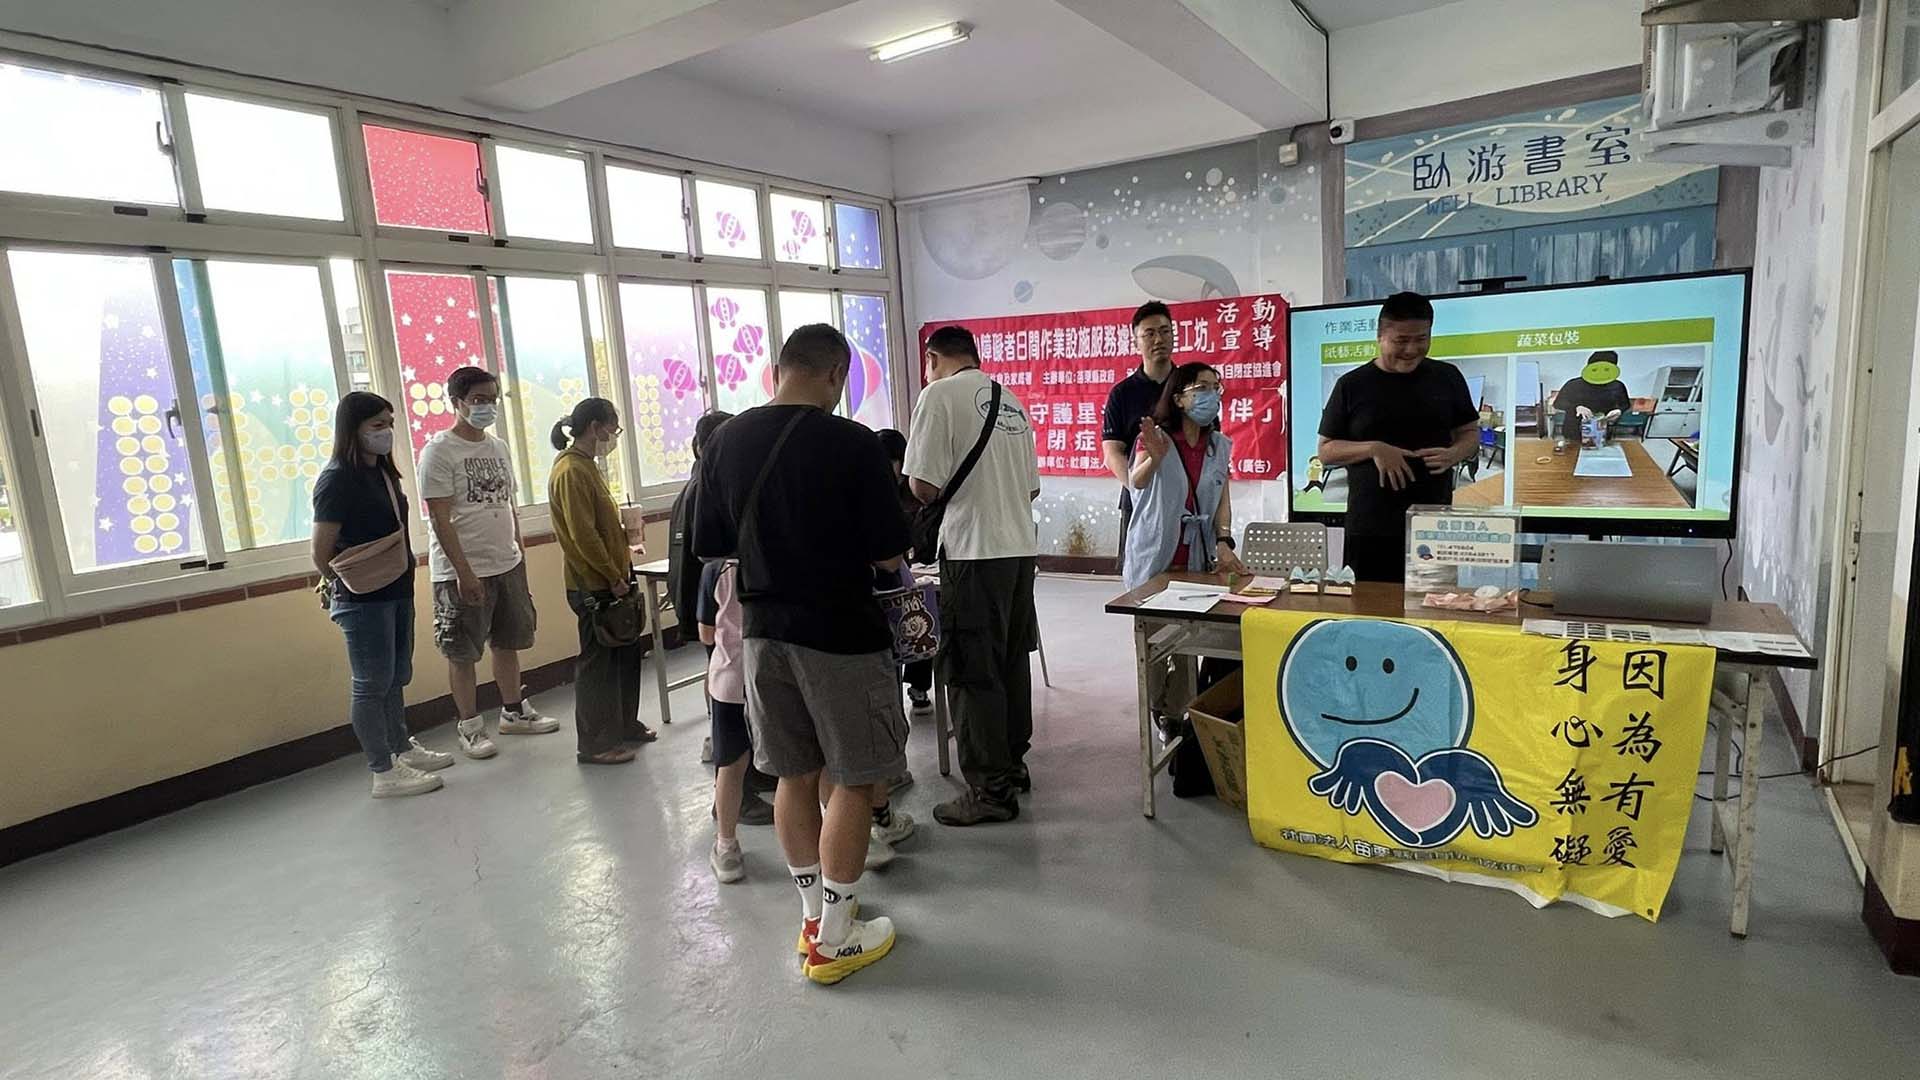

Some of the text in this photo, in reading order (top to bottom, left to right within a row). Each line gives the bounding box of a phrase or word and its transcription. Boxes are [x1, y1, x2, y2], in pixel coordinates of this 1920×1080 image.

[1413, 126, 1631, 191] 臥游書室
[1427, 172, 1607, 216] WELL LIBRARY
[1216, 297, 1276, 323] 活動
[1221, 323, 1277, 351] 宣導
[1029, 402, 1105, 425] 守護星
[1033, 428, 1097, 451] 閉症
[1550, 639, 1604, 870] 身心無礙
[1599, 649, 1668, 868] 因為有愛
[835, 943, 863, 958] HOKA
